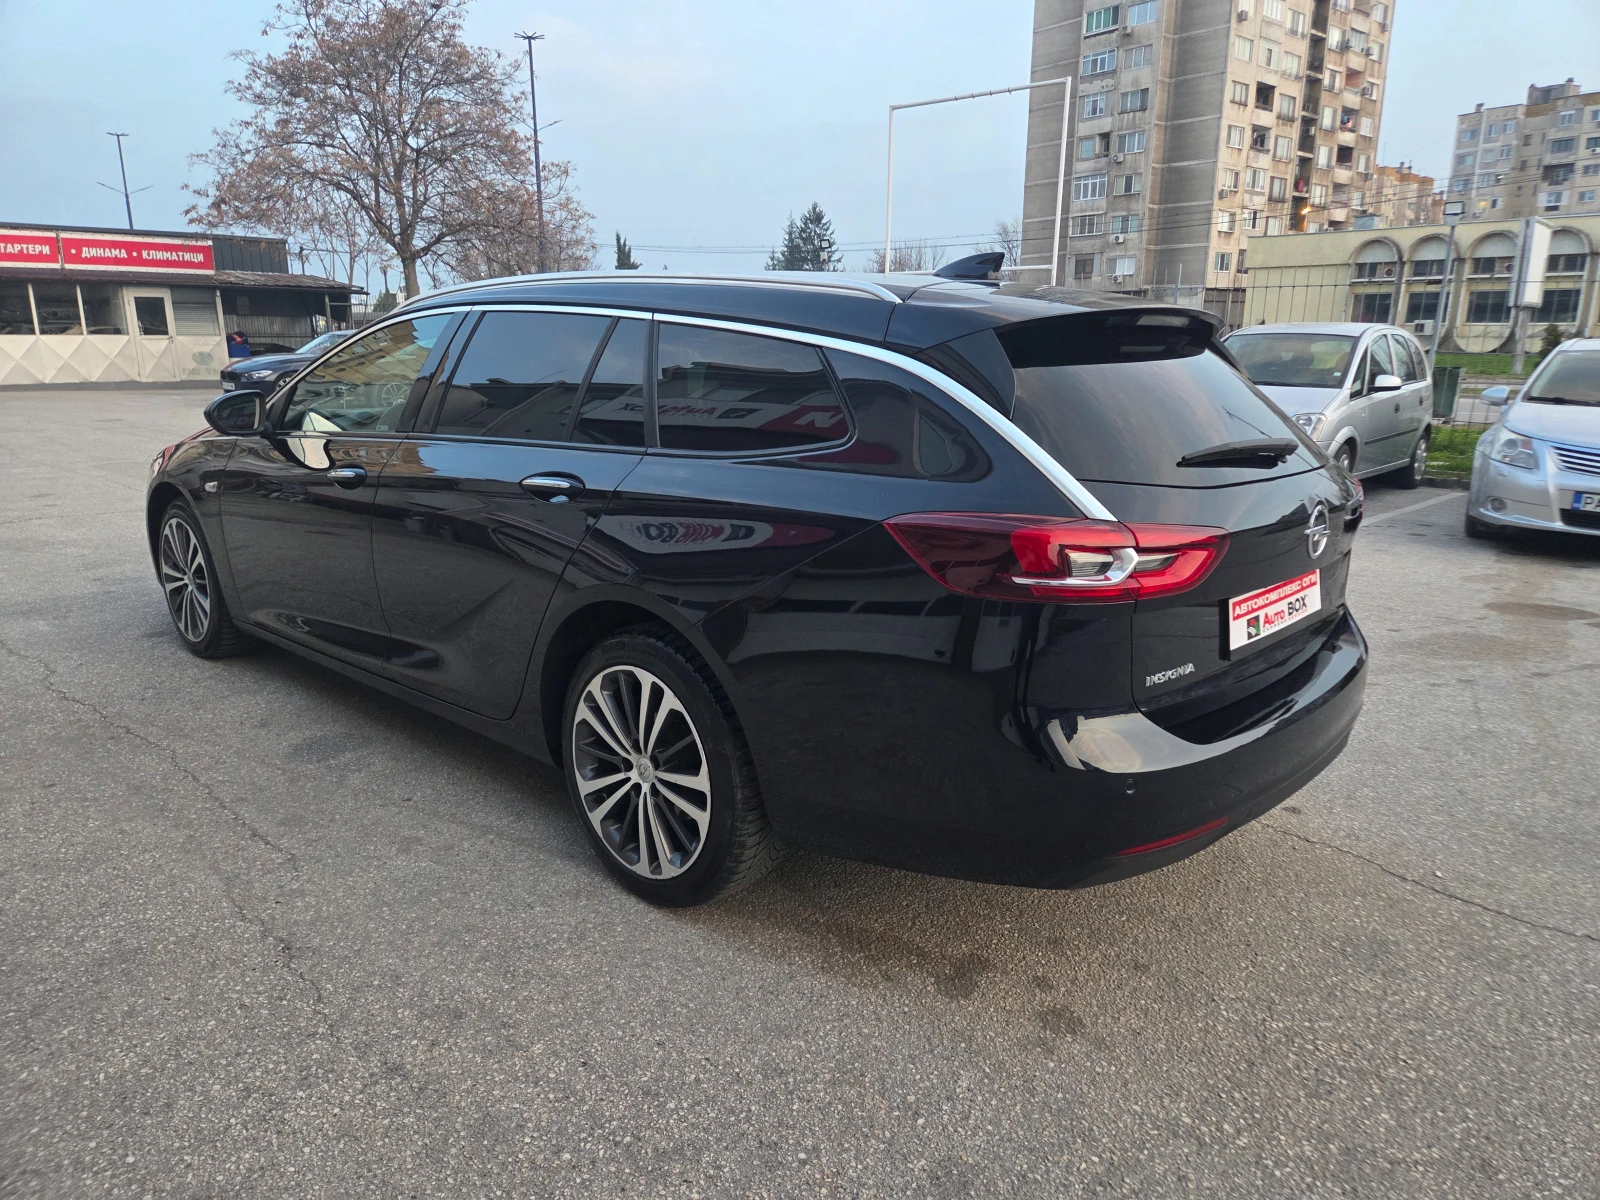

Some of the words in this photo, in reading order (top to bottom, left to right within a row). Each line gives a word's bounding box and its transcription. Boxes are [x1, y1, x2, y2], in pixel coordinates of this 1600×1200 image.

[81, 246, 128, 259] ДИНАМА
[141, 249, 204, 263] КЛИМАТИЦИ
[1233, 580, 1302, 617] АВТОКОМПЛЕКС
[1302, 573, 1317, 587] ОГИ
[1287, 594, 1307, 617] BOX
[1145, 662, 1196, 687] INSIGNIA
